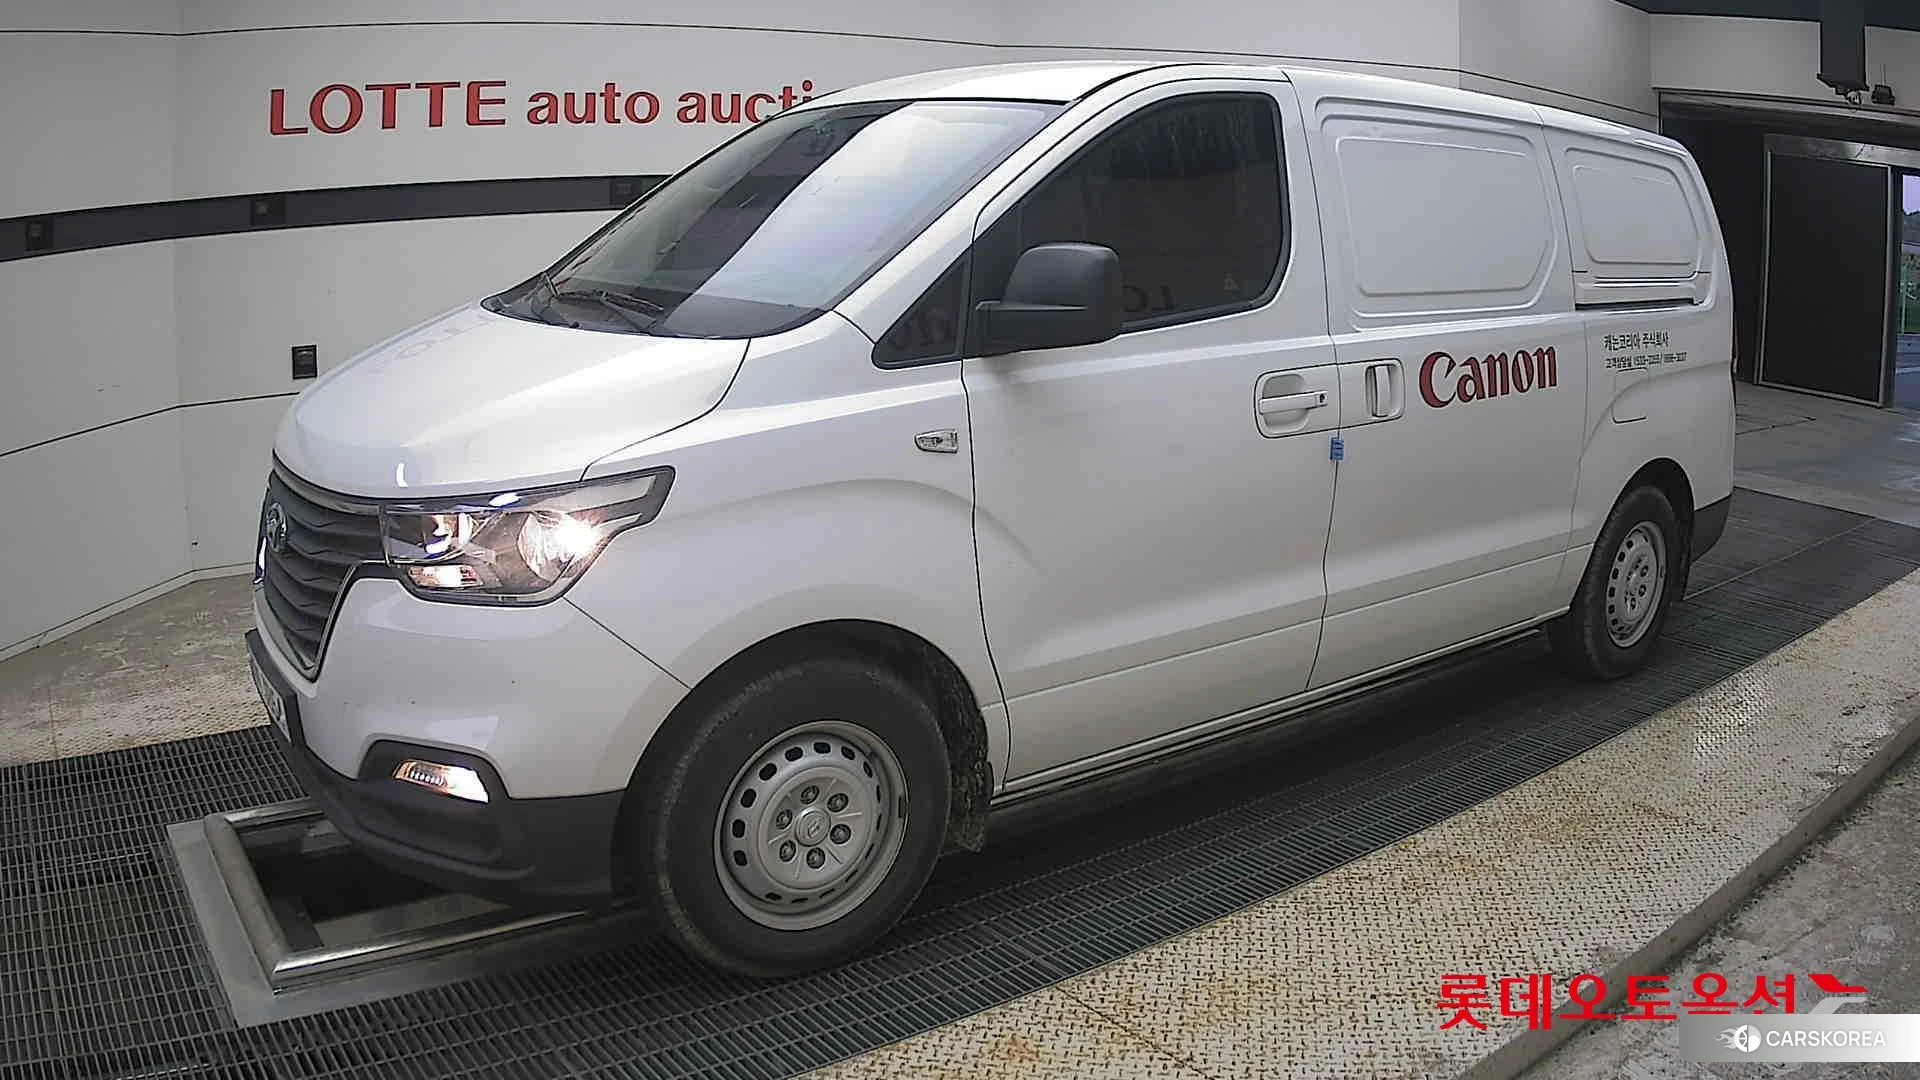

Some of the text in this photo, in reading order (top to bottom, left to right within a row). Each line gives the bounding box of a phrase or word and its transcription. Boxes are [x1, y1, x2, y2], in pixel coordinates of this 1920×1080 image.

[270, 80, 507, 135] LOTTE
[526, 83, 661, 125] auto
[1603, 330, 1669, 351] 캐논코리아 주식회사
[1418, 346, 1558, 408] Canon
